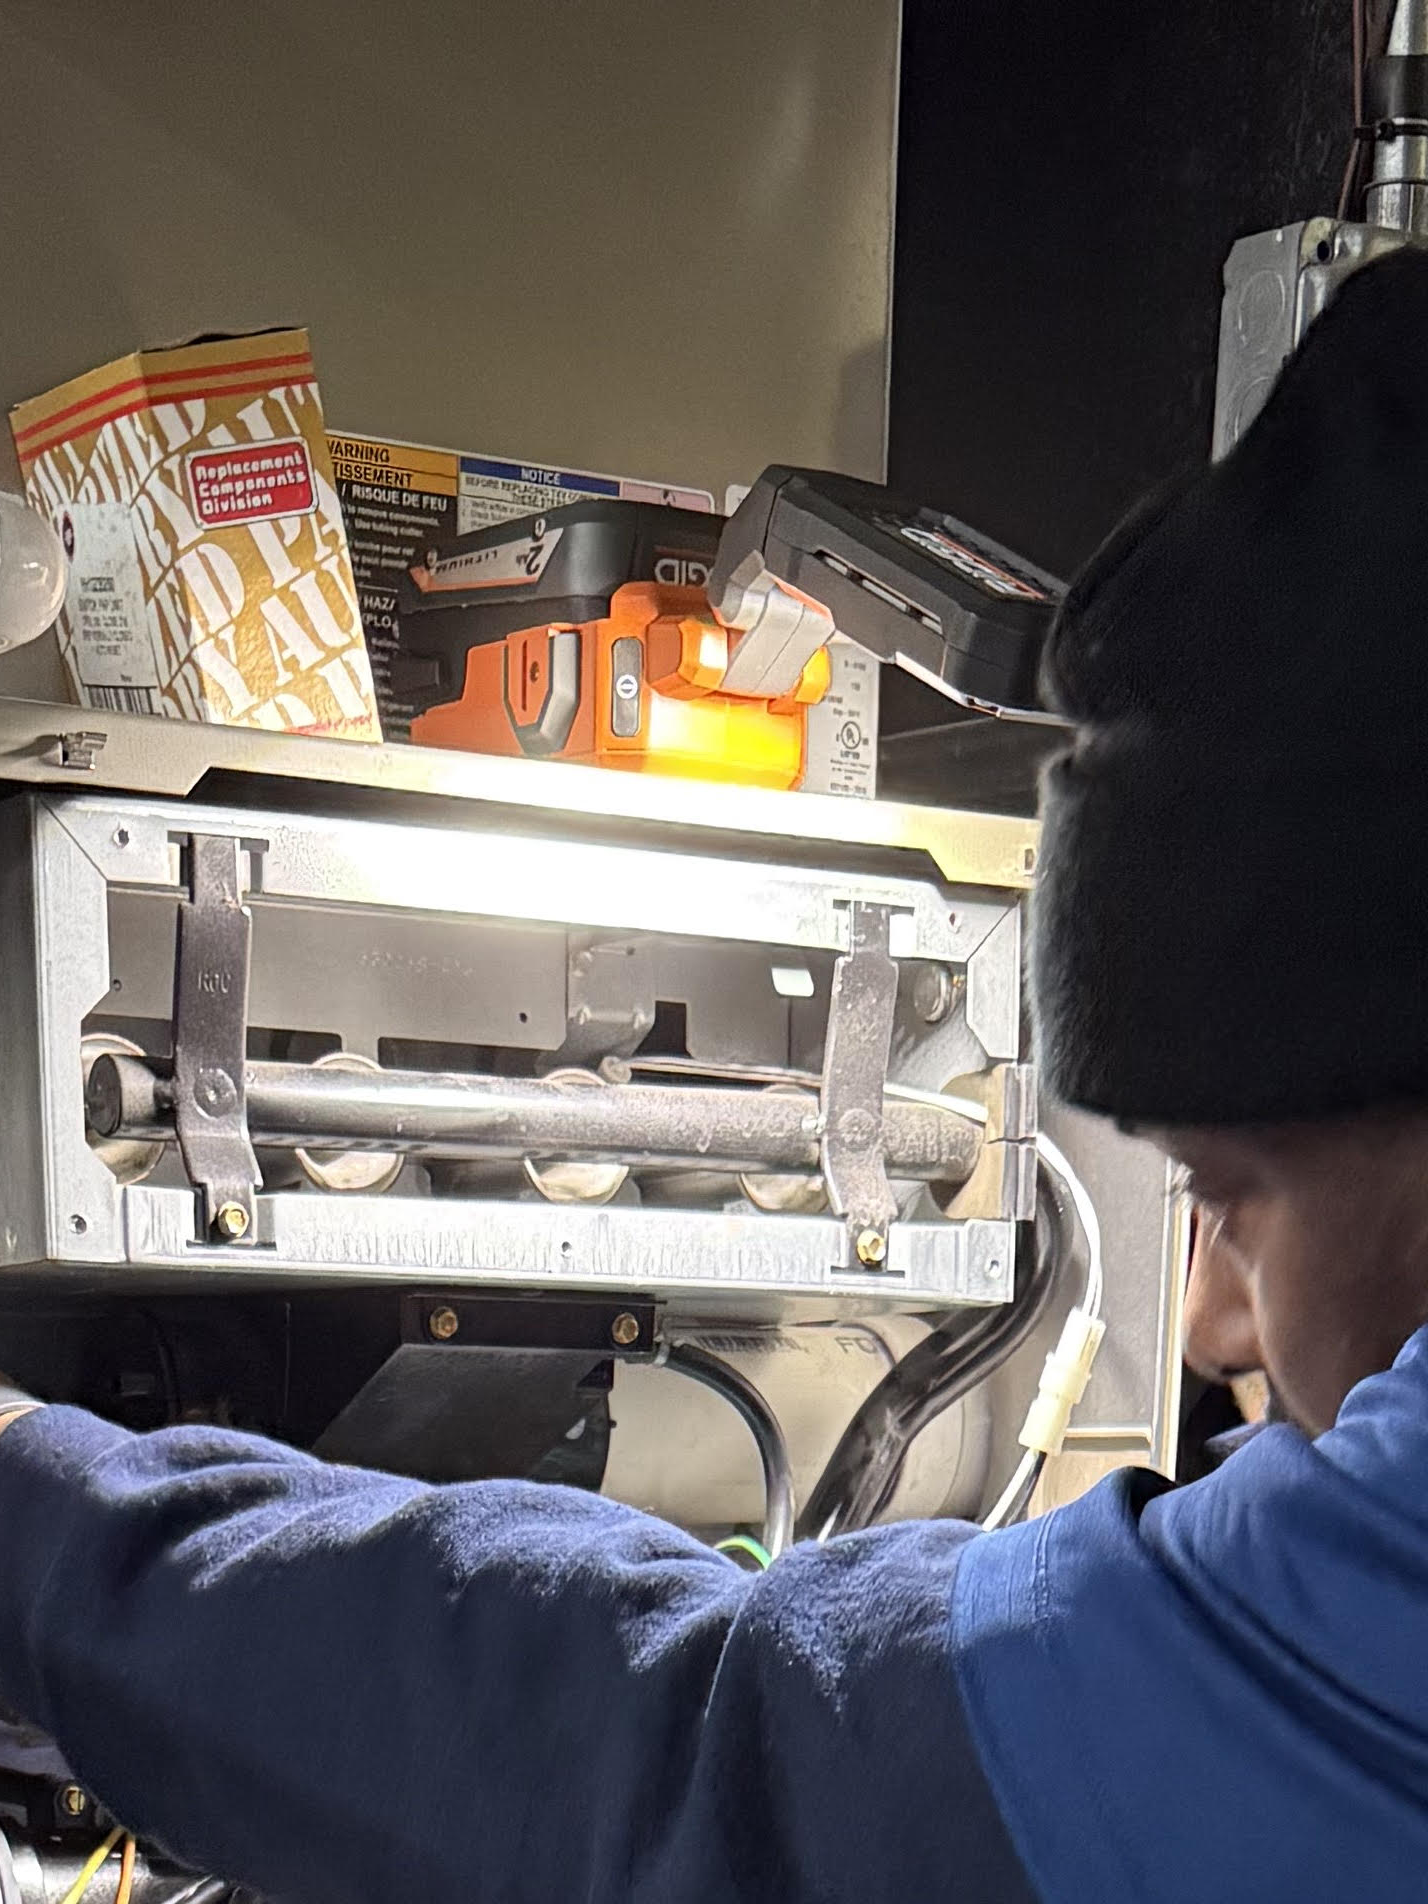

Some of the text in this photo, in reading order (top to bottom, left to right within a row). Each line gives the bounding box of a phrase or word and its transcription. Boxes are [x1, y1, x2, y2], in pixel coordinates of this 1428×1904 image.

[195, 450, 303, 481] Replacement
[332, 461, 414, 488] TISSEMENT
[521, 467, 561, 486] NOTICE
[198, 469, 307, 498] Components
[201, 493, 274, 516] Division
[352, 484, 400, 504] RISQUE
[402, 494, 420, 508] DE
[422, 496, 448, 512] FEU
[654, 558, 713, 587] GID
